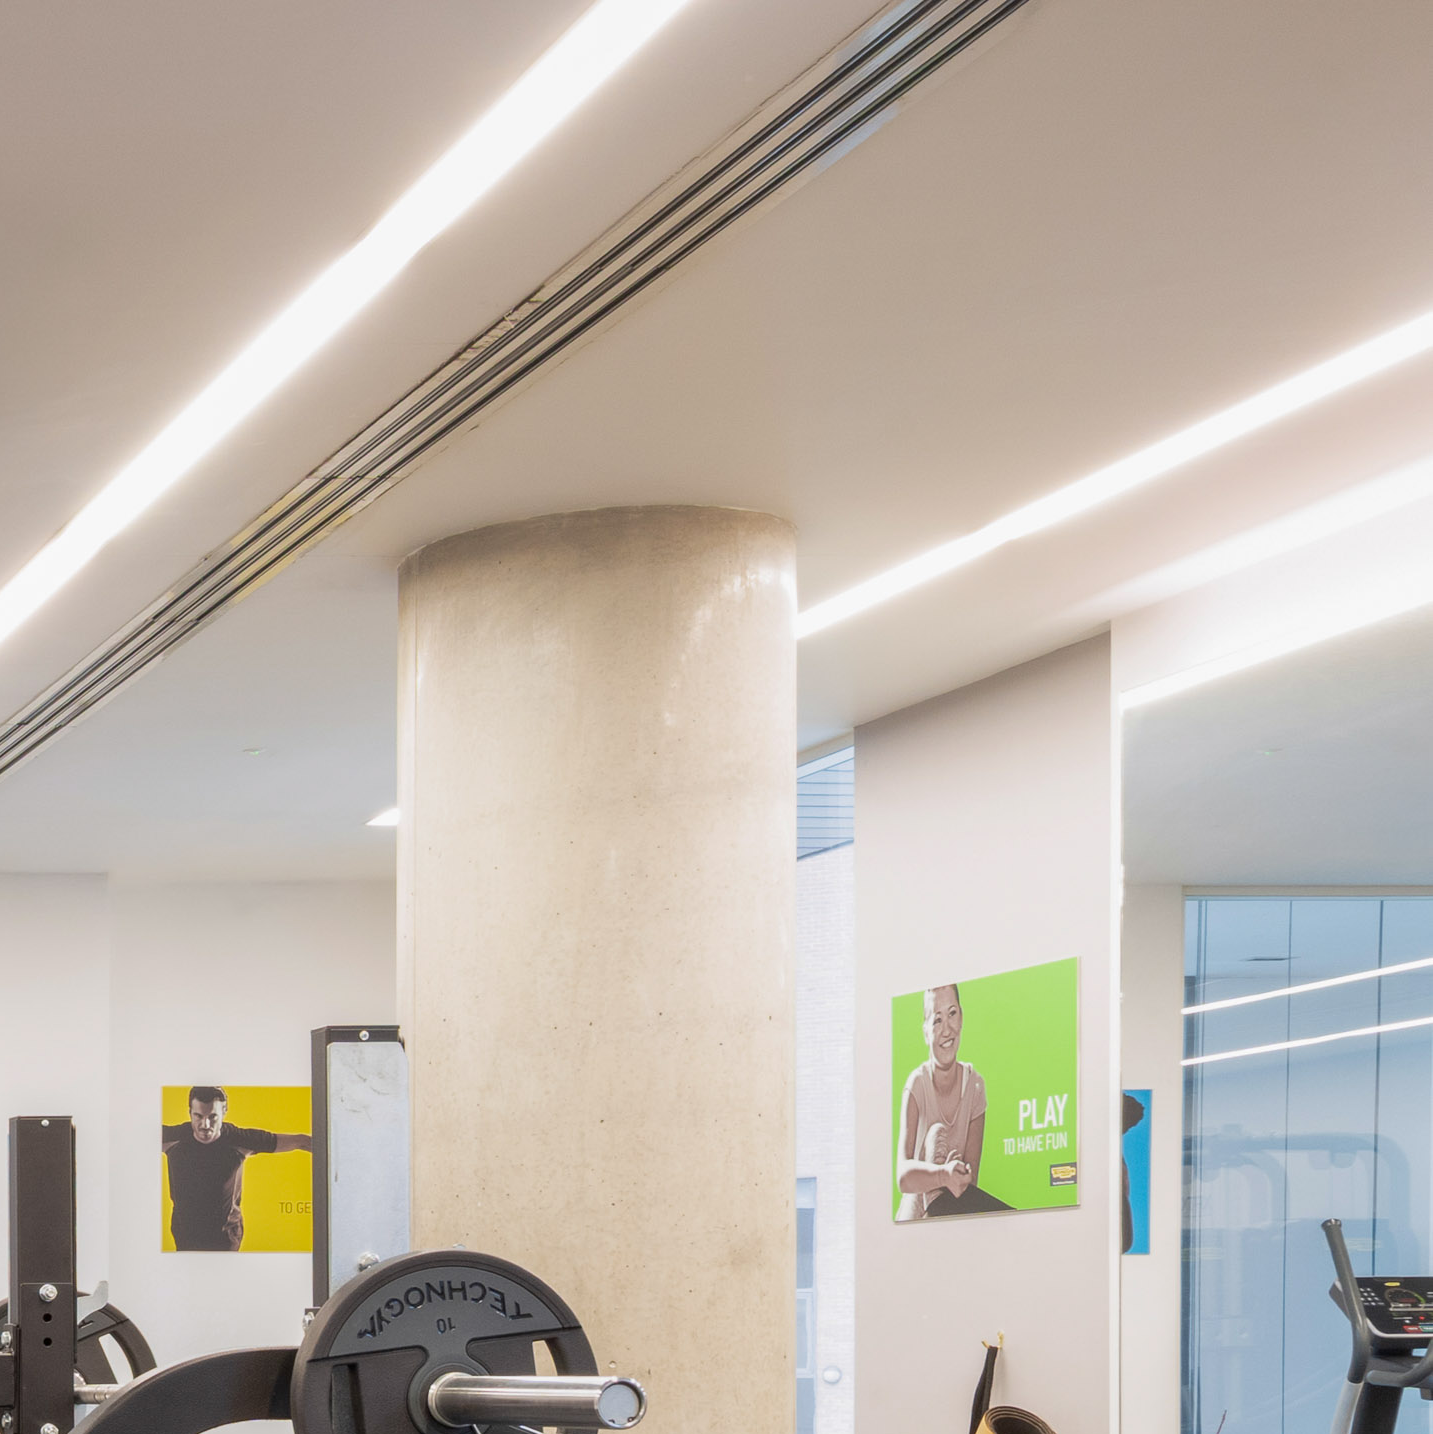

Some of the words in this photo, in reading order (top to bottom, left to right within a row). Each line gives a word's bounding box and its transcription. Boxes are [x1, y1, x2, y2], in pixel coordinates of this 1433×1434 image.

[1019, 1093, 1068, 1132] PLAY
[1003, 1137, 1015, 1155] TO
[1017, 1134, 1044, 1154] HAVE
[1046, 1131, 1068, 1150] FUN
[278, 1201, 293, 1214] TO
[296, 1201, 311, 1214] GE
[356, 1280, 533, 1340] TECHNOGYM
[435, 1317, 456, 1334] 10
